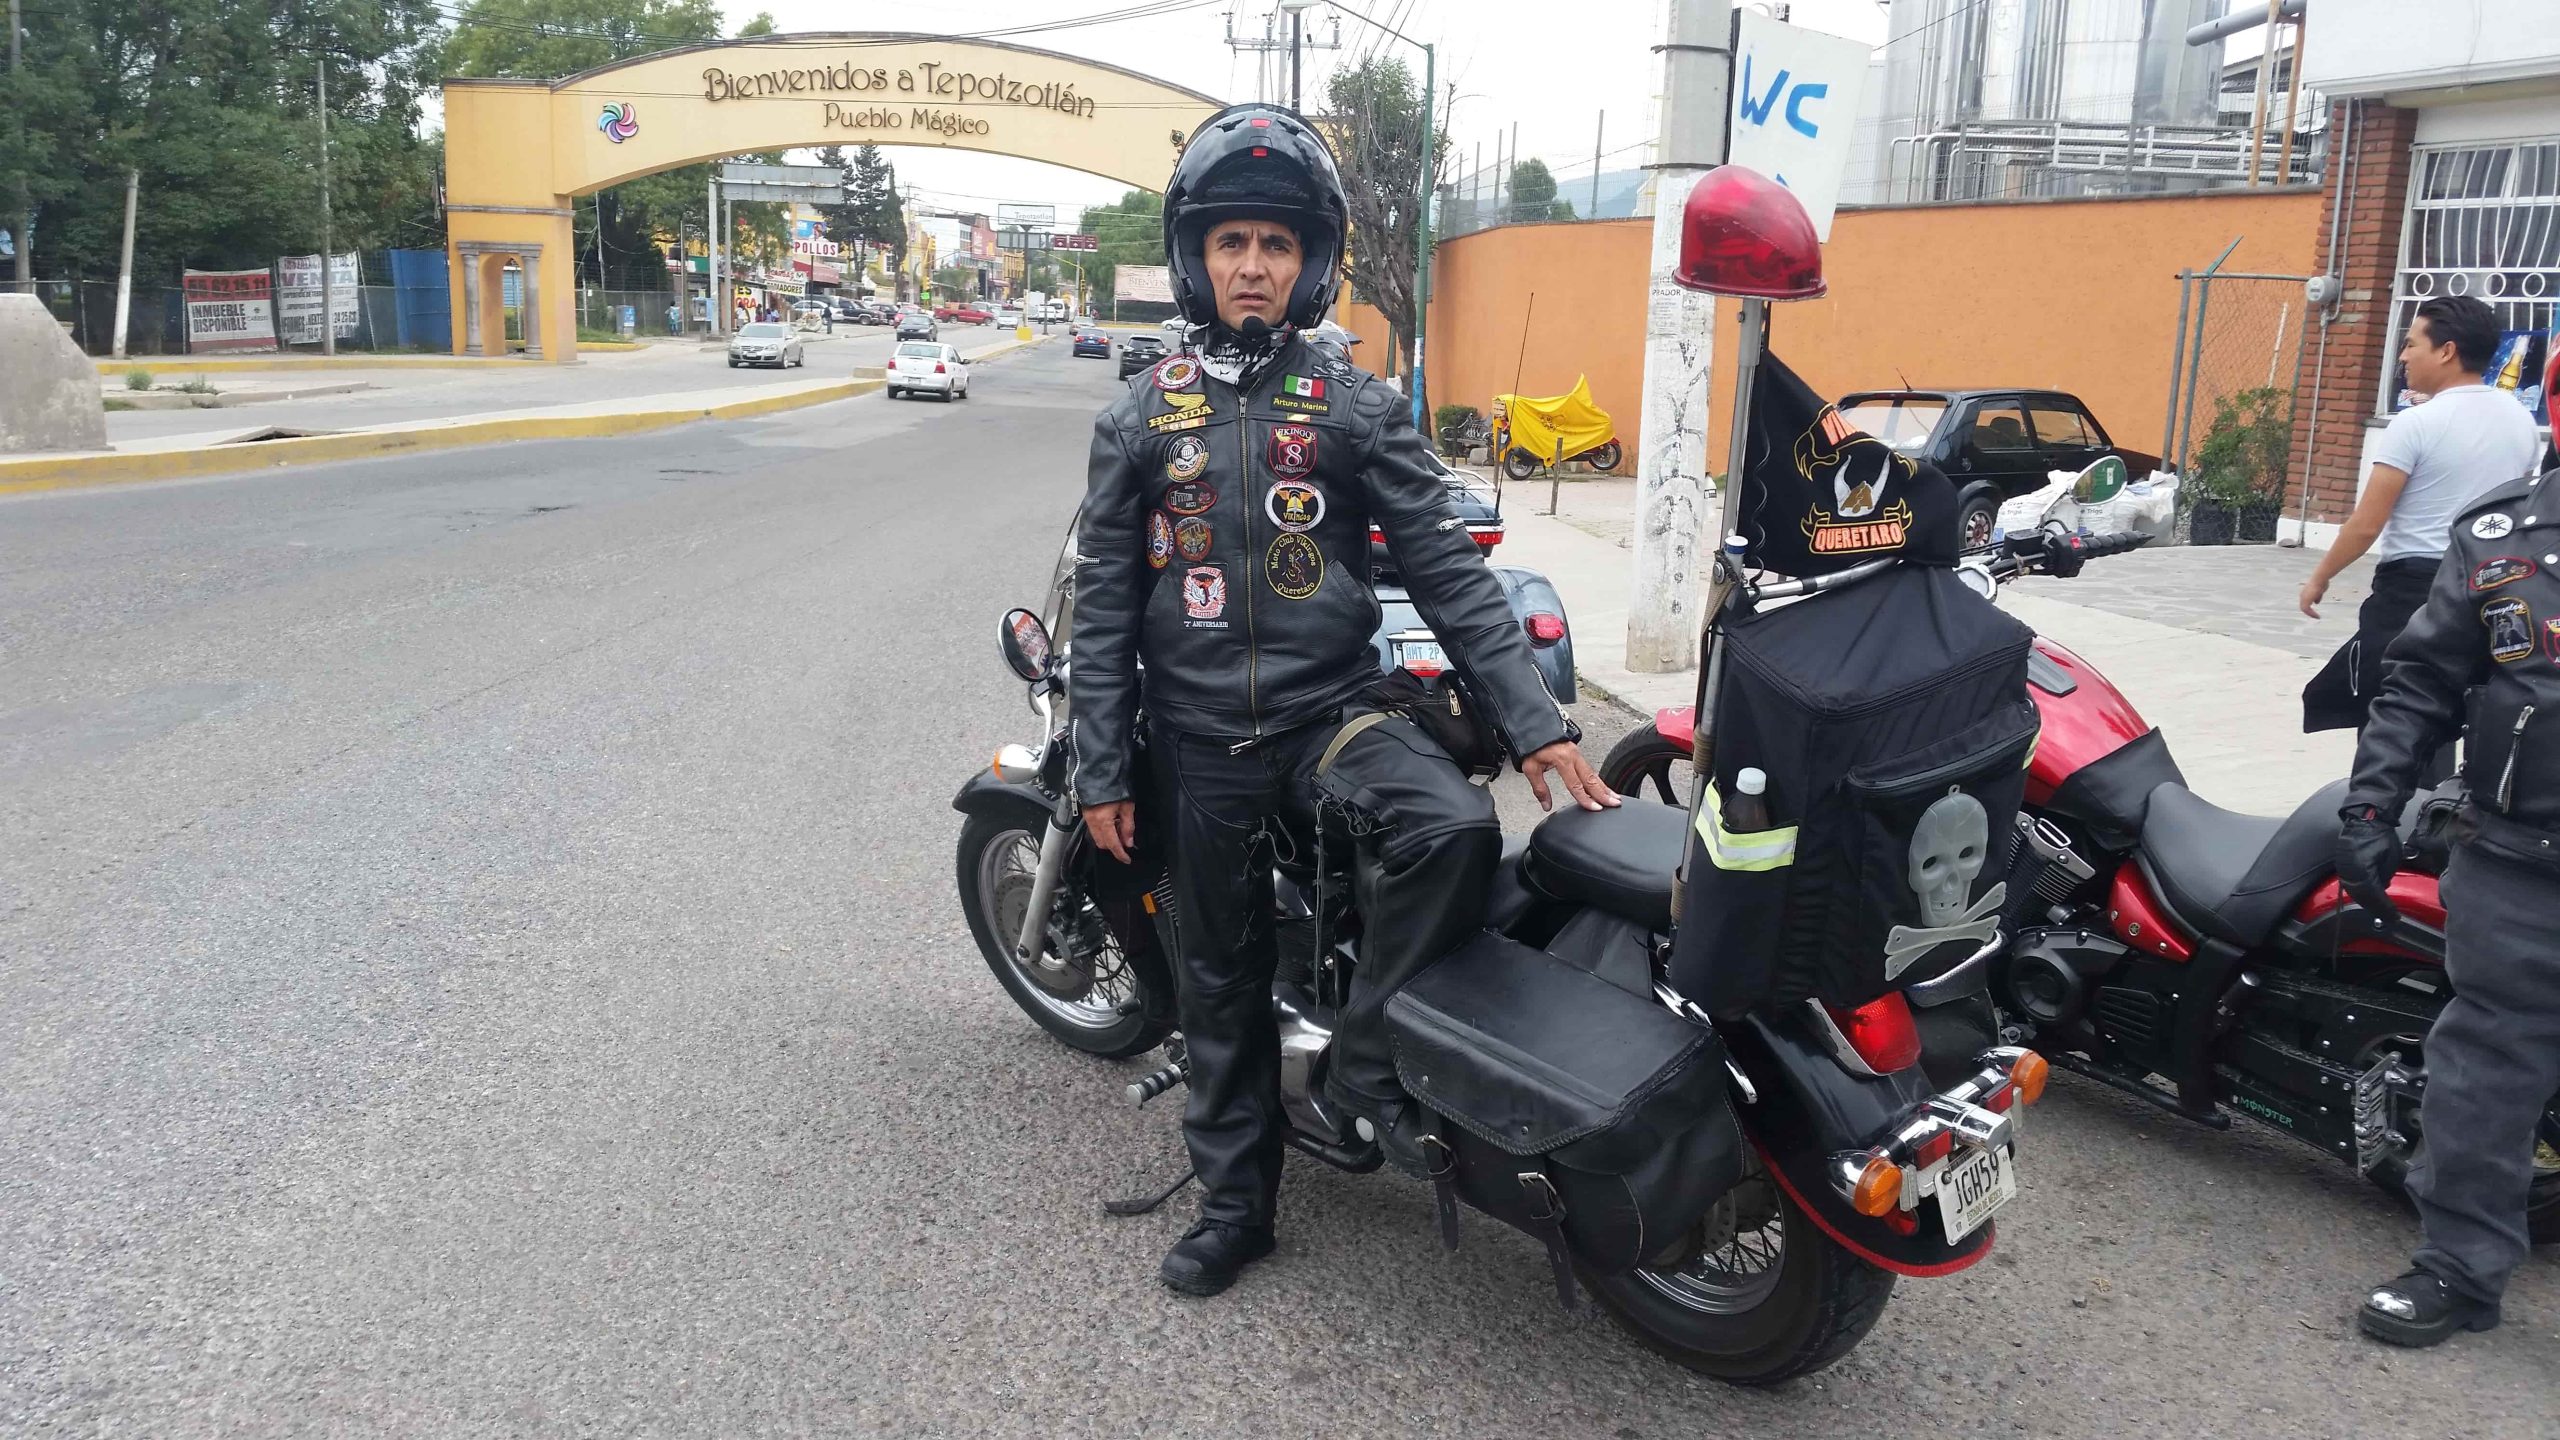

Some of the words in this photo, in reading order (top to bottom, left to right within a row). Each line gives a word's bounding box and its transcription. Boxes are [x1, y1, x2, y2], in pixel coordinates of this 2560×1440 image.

[703, 60, 888, 101] Bienvenidos
[898, 69, 914, 93] a
[919, 61, 1095, 119] Tepotzotlán
[1741, 54, 1828, 139] WC
[823, 102, 902, 129] Pueblo
[910, 109, 990, 137] Mágico
[794, 241, 837, 256] POLLOS
[1129, 277, 1168, 288] BIENVEN
[192, 303, 246, 318] INMUEBLE
[194, 316, 247, 333] DISPONIBLE
[1273, 398, 1298, 408] Arturo
[1148, 405, 1215, 428] HONDA
[1274, 427, 1316, 441] VIKINGOS
[1286, 444, 1303, 467] 8
[1815, 523, 1903, 552] QUERETARO
[1270, 548, 1281, 569] Moto
[1278, 534, 1295, 548] Club
[1296, 535, 1316, 567] Vikingos
[1277, 582, 1315, 595] Queretaro
[1192, 620, 1229, 628] ANIVERSARIO
